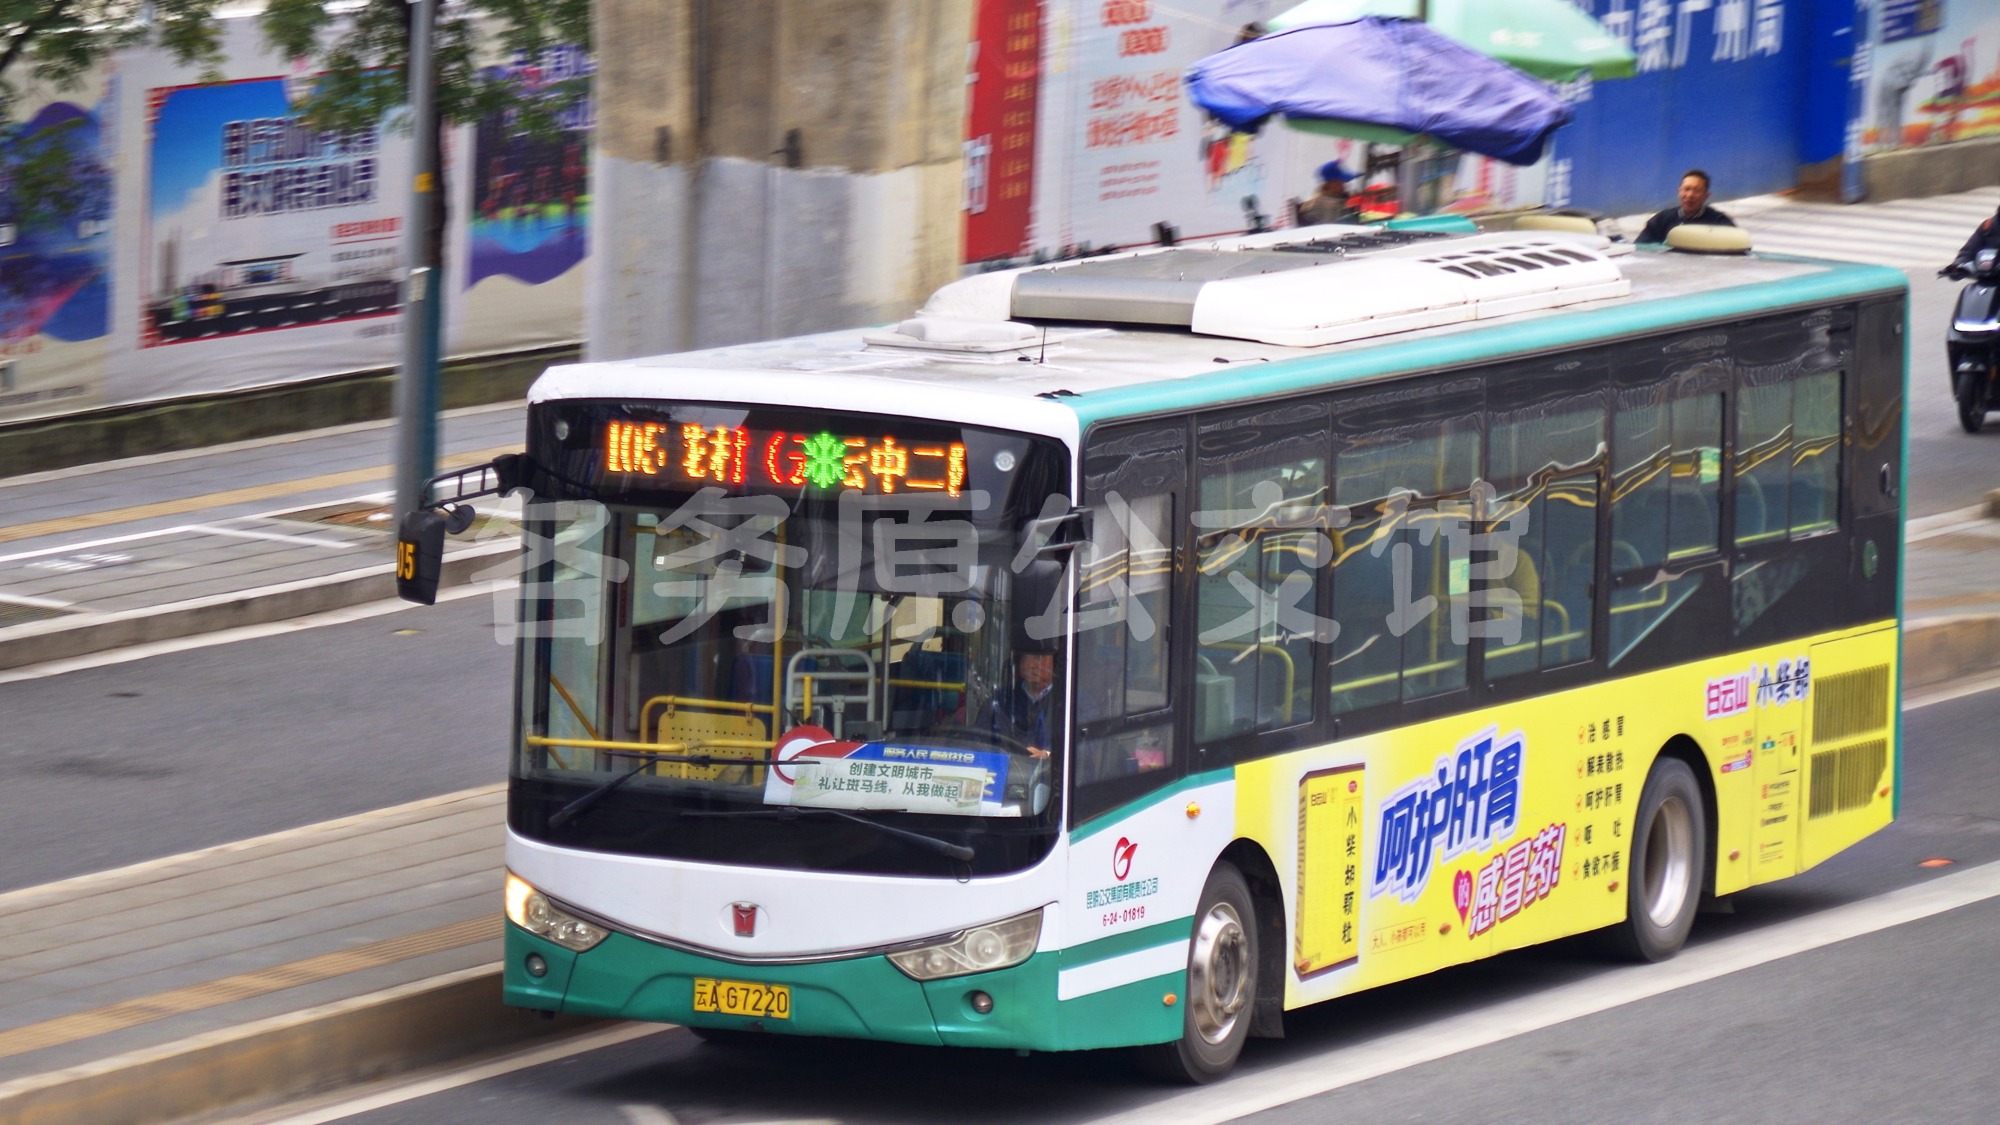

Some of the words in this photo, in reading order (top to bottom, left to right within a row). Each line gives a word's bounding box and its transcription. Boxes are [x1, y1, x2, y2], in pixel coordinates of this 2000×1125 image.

[1707, 675, 1750, 716] 白云山
[849, 762, 934, 780] 创建文明城市
[1373, 735, 1522, 890] 呵护肝胃
